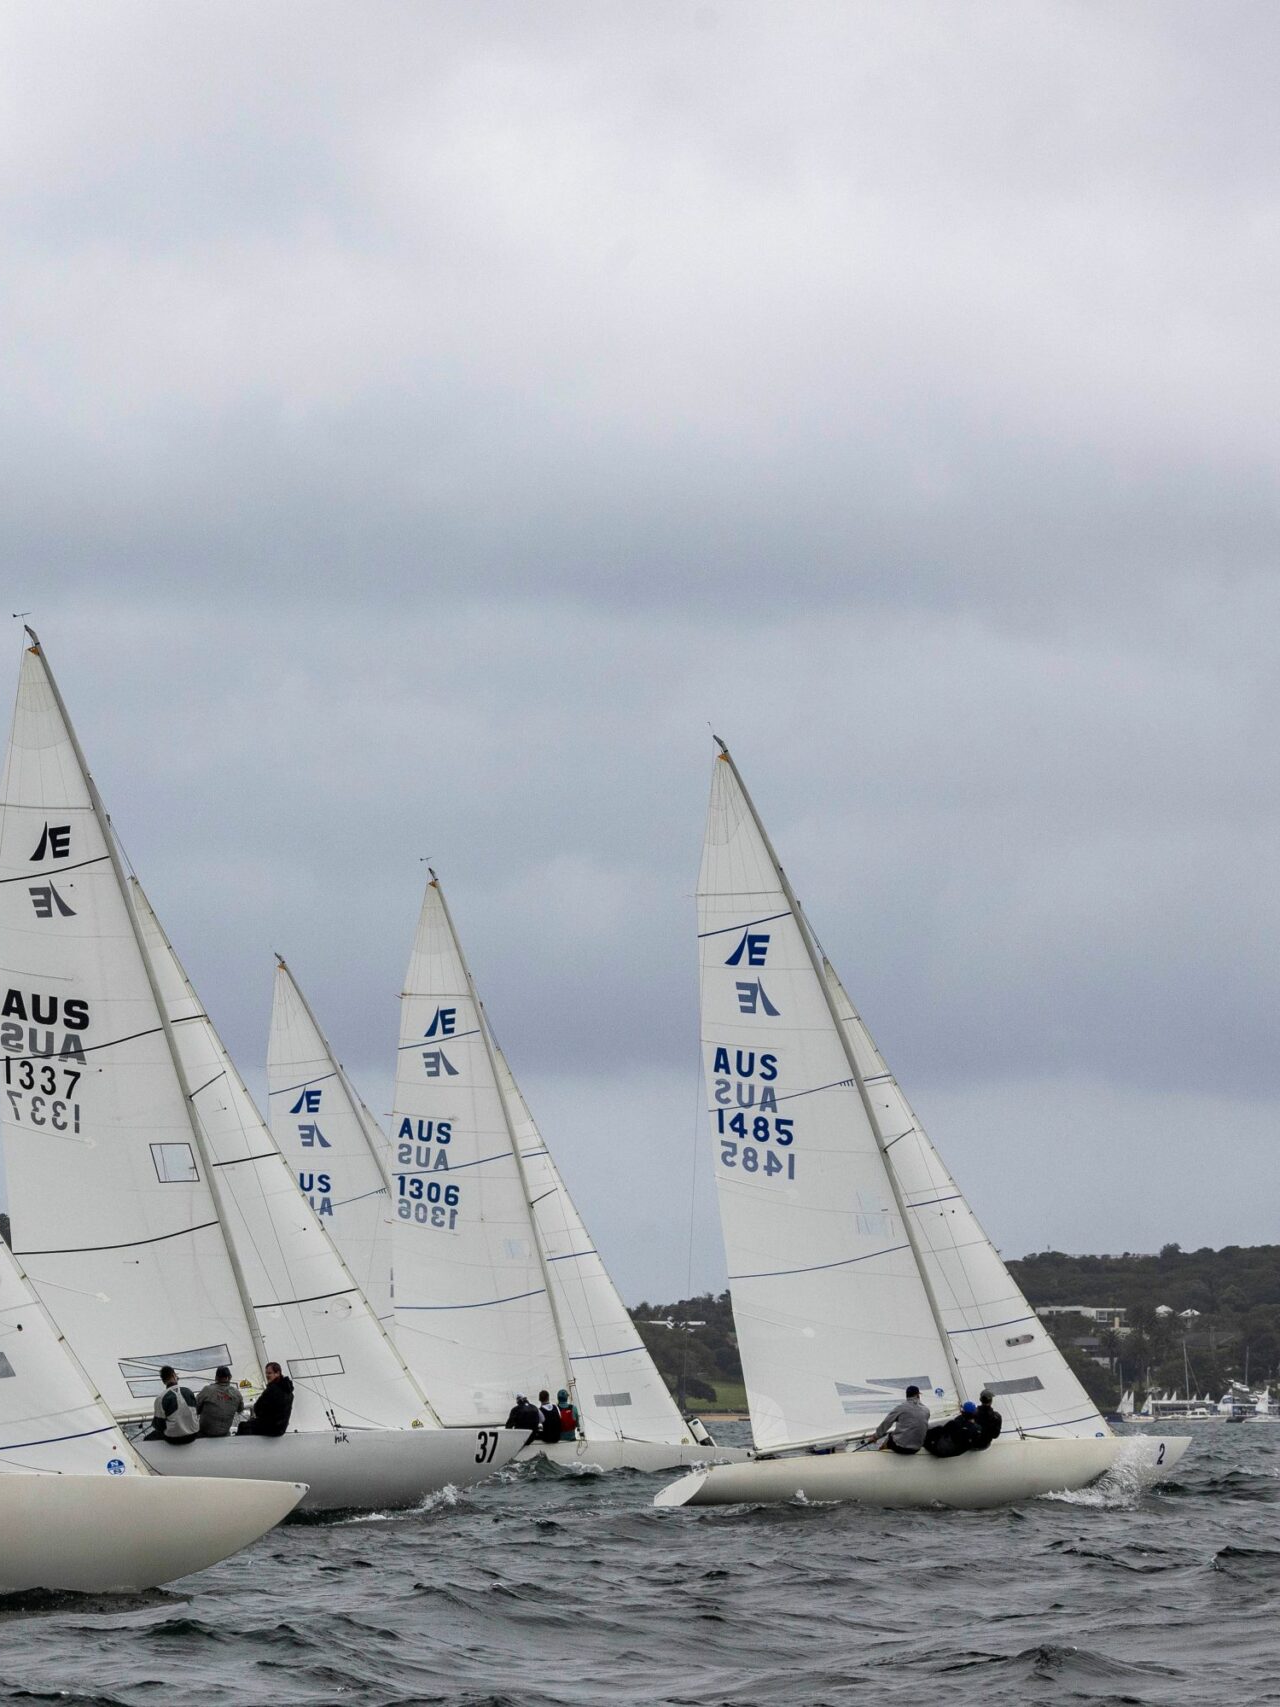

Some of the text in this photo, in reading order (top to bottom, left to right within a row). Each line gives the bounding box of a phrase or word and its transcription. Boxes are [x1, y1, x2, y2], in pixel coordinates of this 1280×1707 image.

[1, 989, 90, 1030] AUS
[5, 1056, 81, 1100] 1337
[713, 1047, 778, 1081] AUS
[398, 1118, 452, 1145] AUS
[718, 1109, 794, 1146] 1485
[299, 1173, 331, 1194] US
[398, 1176, 460, 1207] 1306
[475, 1431, 498, 1463] 37
[1157, 1443, 1166, 1465] 2
